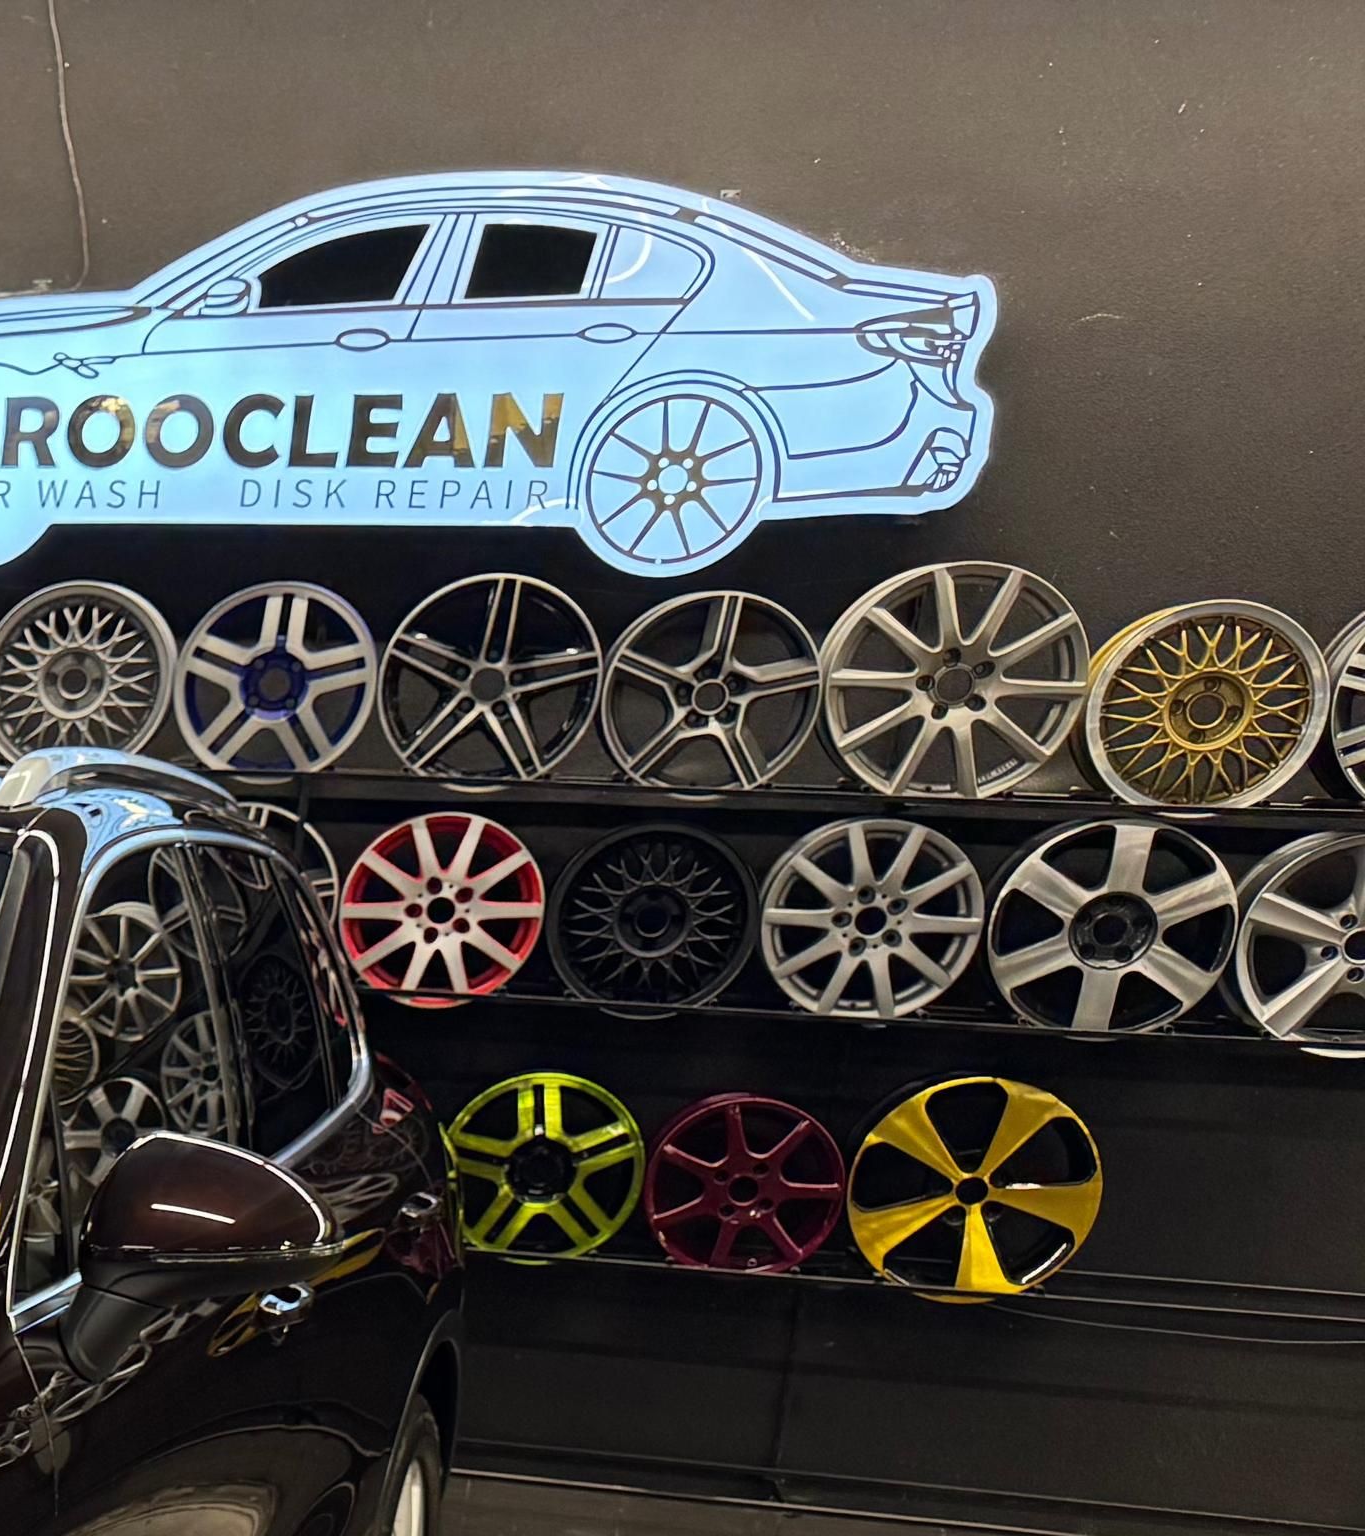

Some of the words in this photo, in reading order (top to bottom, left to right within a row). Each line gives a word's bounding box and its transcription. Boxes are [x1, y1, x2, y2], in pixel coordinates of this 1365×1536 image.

[37, 478, 162, 510] WASH
[239, 478, 349, 510] DISK
[374, 478, 549, 510] REPAIR
